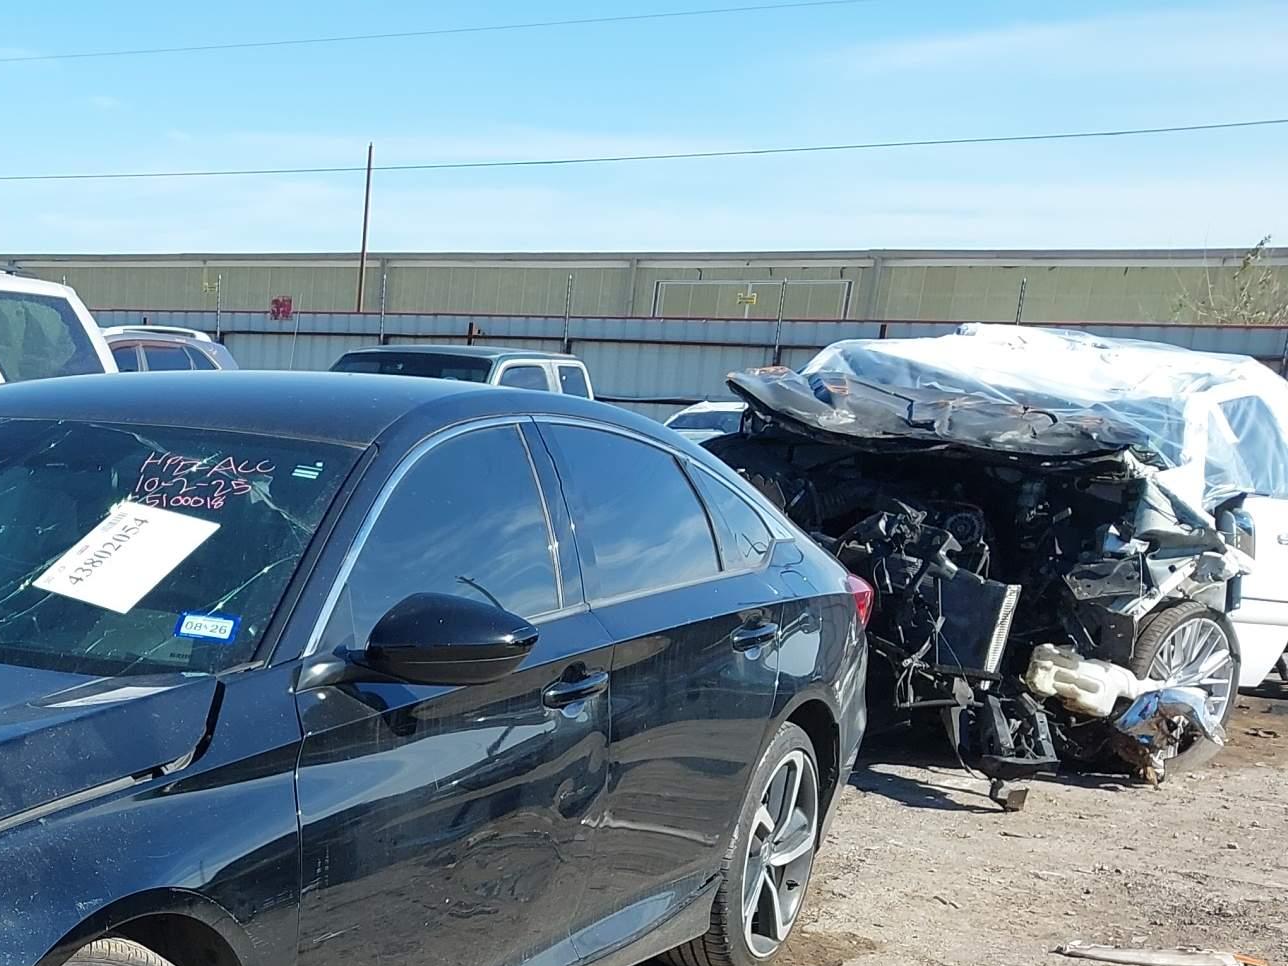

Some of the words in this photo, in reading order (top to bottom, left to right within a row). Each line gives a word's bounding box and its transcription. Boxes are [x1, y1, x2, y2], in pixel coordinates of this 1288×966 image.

[68, 517, 149, 585] 43802054
[184, 621, 202, 631] 08
[209, 623, 228, 634] 26
